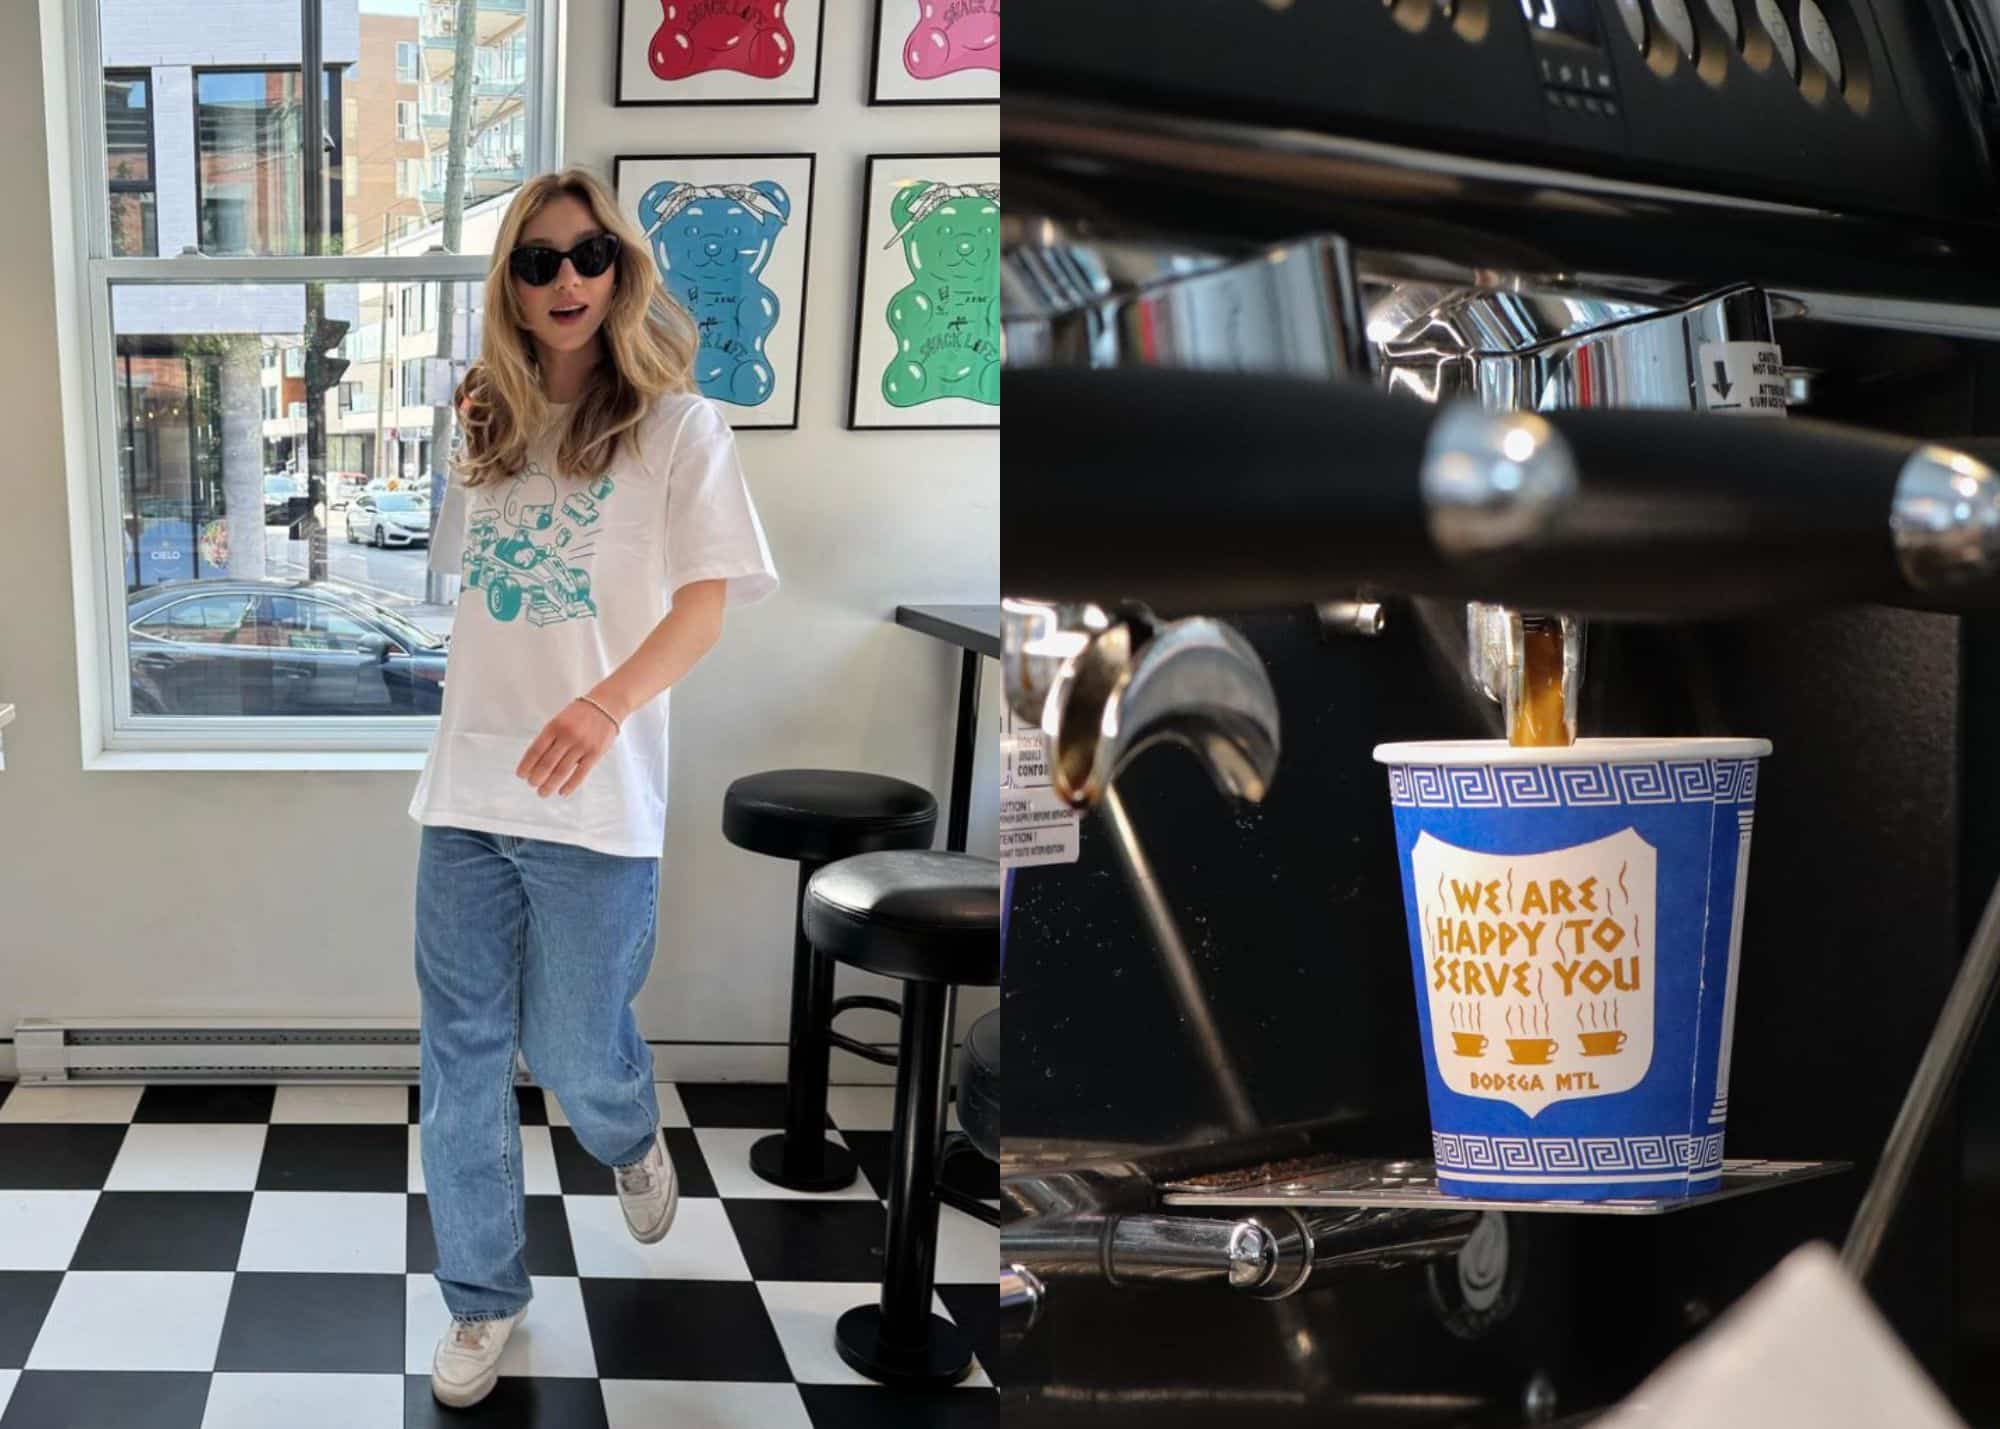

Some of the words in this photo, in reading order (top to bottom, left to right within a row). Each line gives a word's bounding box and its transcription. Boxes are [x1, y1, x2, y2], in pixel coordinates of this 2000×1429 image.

[1451, 879, 1502, 916] WE
[1521, 876, 1598, 916] ARE
[1437, 917, 1546, 957] HAPPY
[1565, 917, 1625, 955] TO
[1433, 956, 1531, 998] SERVE
[1552, 956, 1641, 997] YOU
[1470, 1072, 1544, 1091] BODEGA
[1556, 1072, 1600, 1091] MTL
